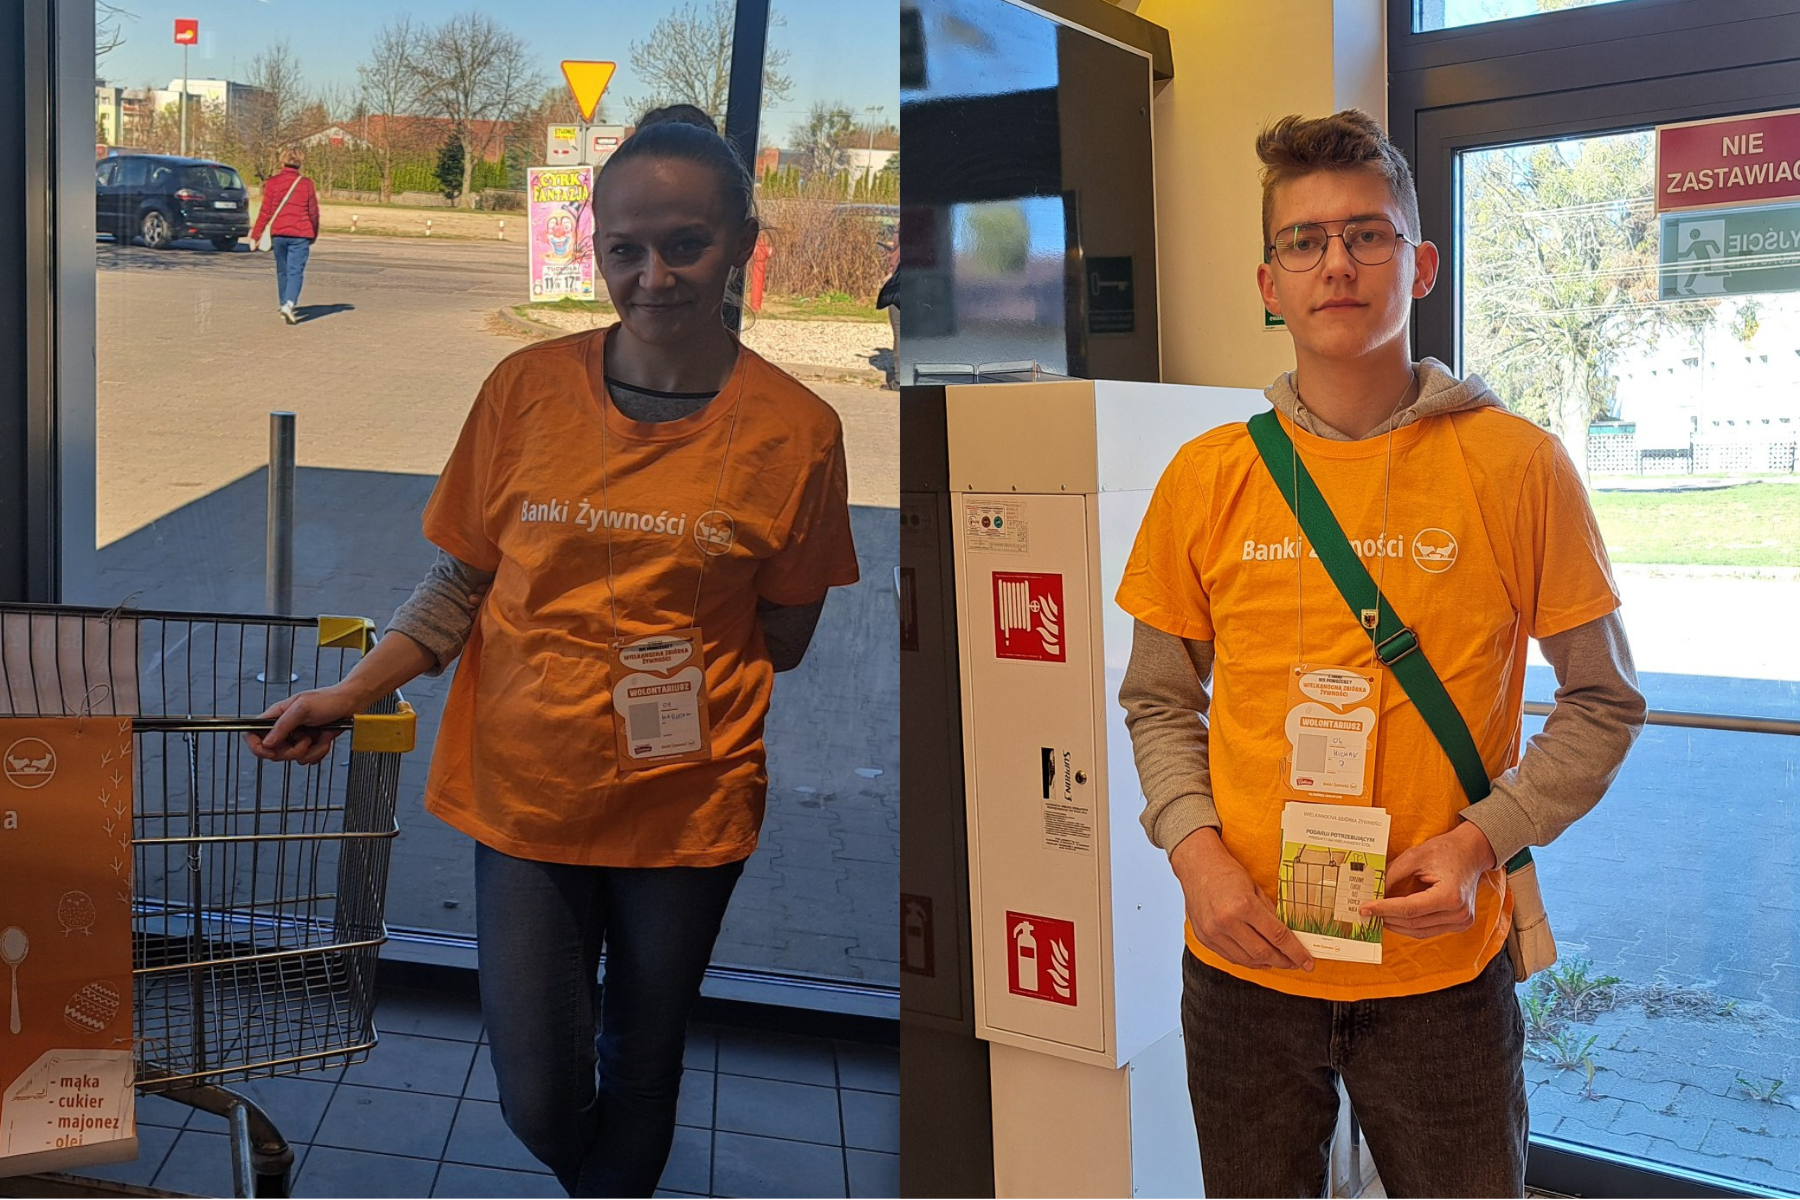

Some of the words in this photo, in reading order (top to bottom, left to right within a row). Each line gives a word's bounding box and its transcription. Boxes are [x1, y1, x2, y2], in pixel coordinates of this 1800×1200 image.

[1722, 132, 1764, 157] NIE
[540, 172, 581, 187] CYRK
[533, 184, 589, 202] FANTAZJA
[521, 498, 570, 523] Banki
[574, 497, 687, 536] Żywności
[1241, 536, 1302, 561] Banki
[1308, 532, 1404, 559] ności
[629, 682, 690, 697] WOLONTARIUSZ
[1301, 717, 1362, 731] WOLONTARIUSZ
[1303, 811, 1337, 820] WIELKANOCNA
[1330, 831, 1375, 843] POTRZEBUJĄCYM
[60, 1074, 100, 1092] mąka
[58, 1093, 104, 1109] cukier
[57, 1113, 119, 1132] majonez
